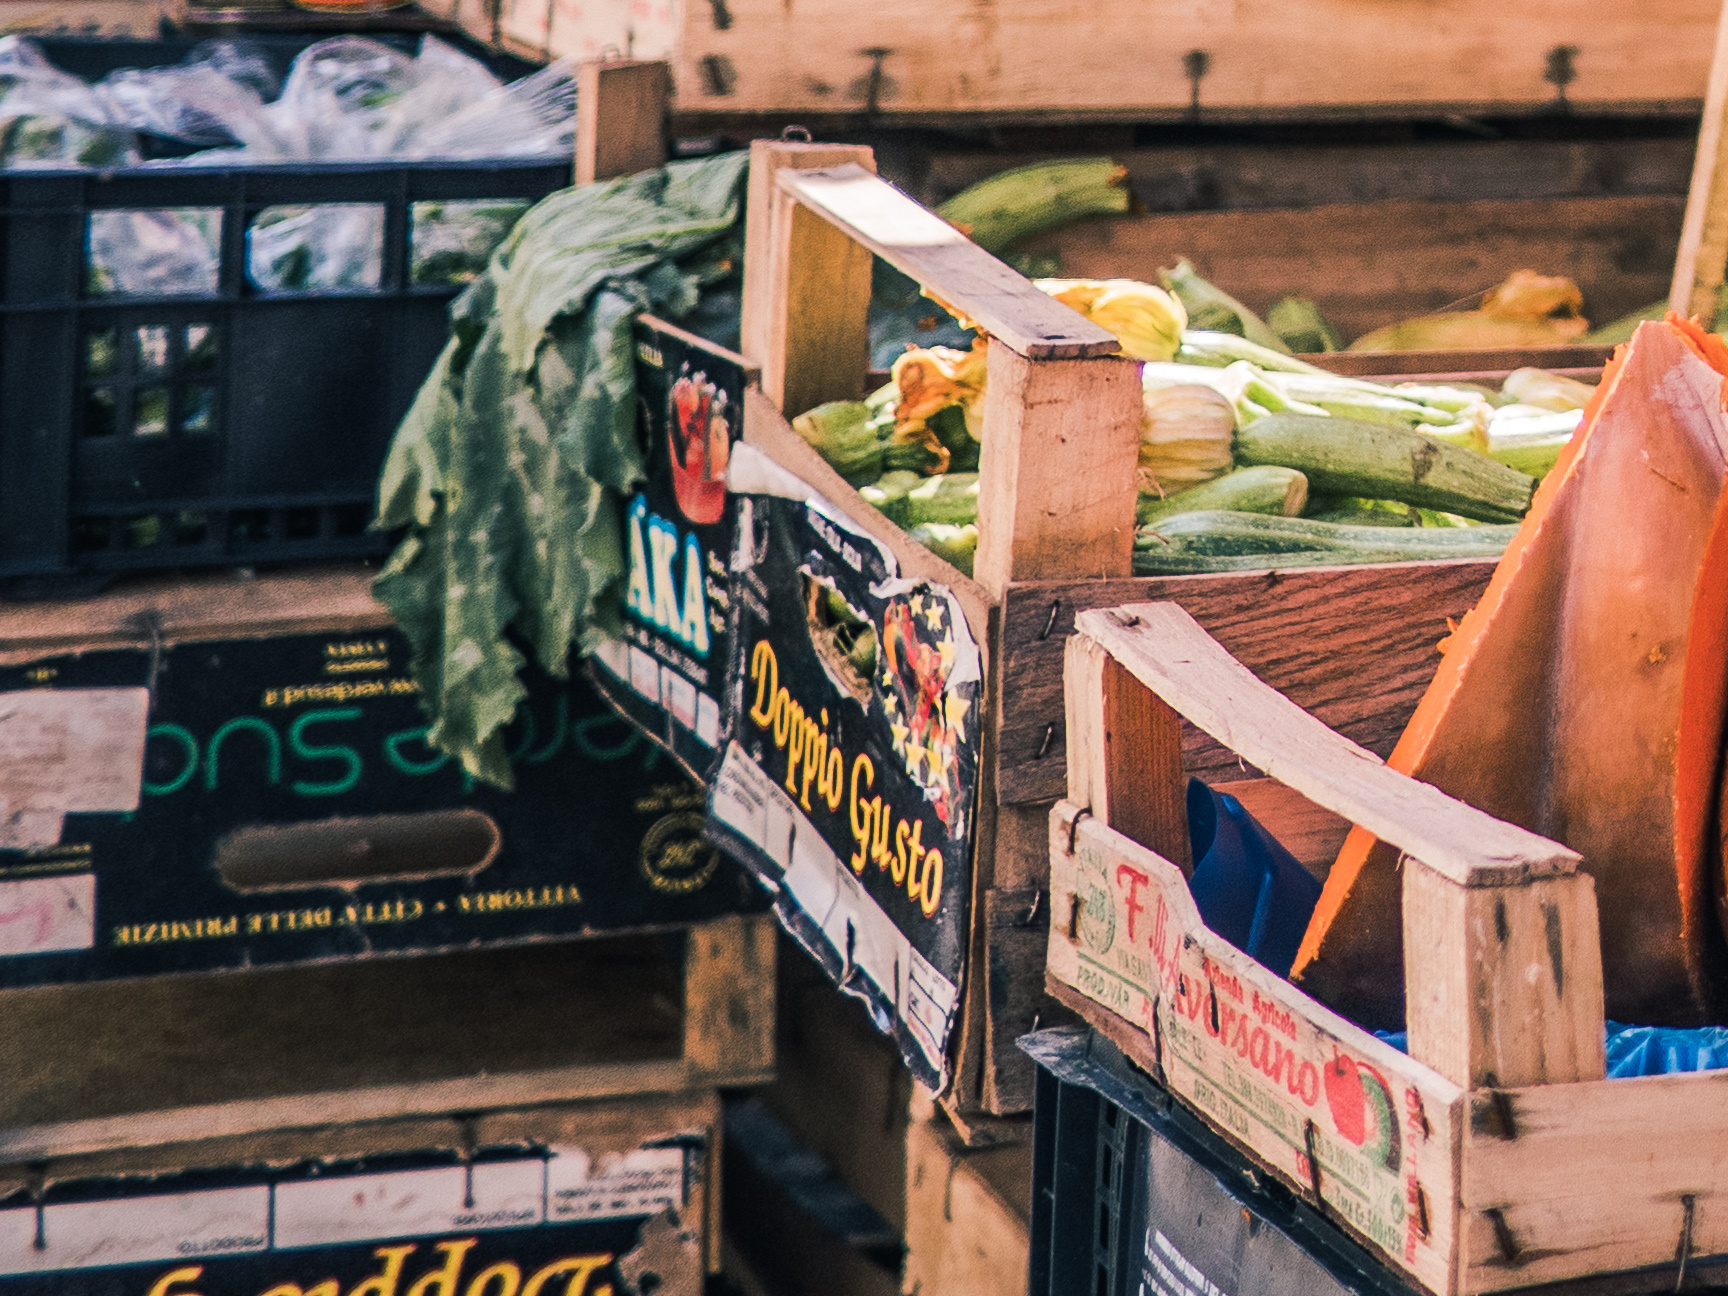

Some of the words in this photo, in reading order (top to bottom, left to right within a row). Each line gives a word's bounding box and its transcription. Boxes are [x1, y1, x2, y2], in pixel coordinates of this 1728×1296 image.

[750, 640, 844, 812] Doppio
[848, 753, 944, 918] Gusto
[460, 885, 581, 910] VITTORIA
[114, 915, 238, 948] PRIMIZIE
[247, 907, 331, 937] DELLE
